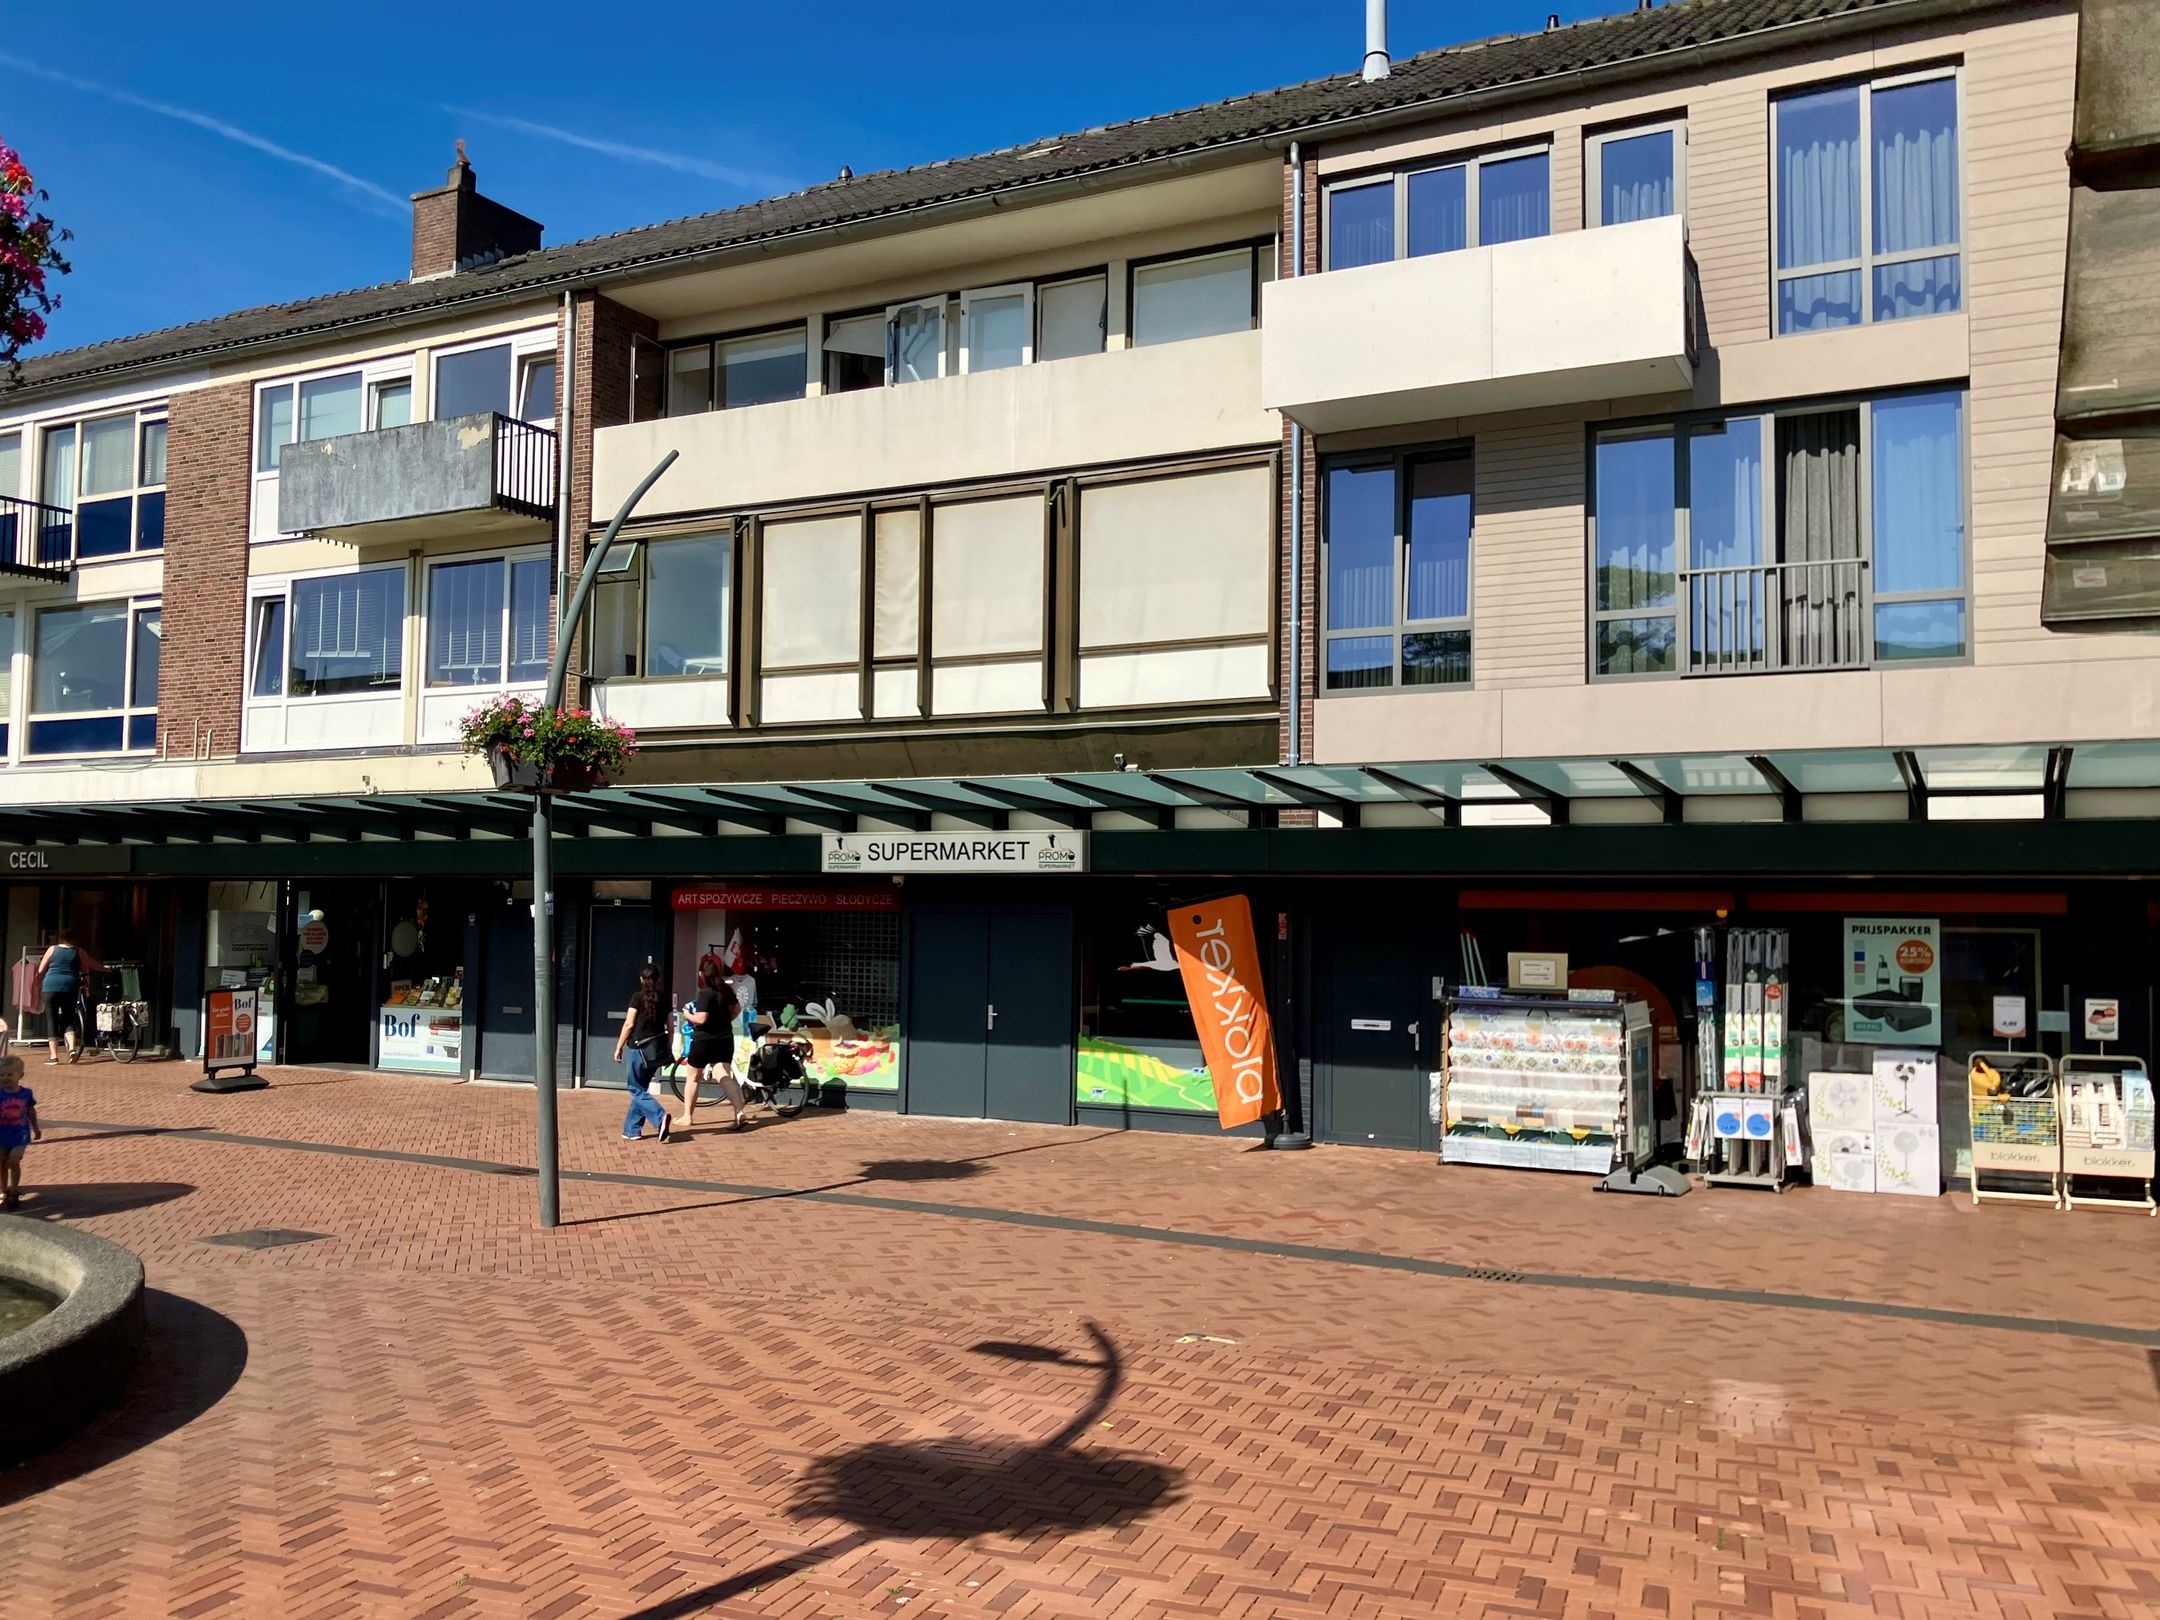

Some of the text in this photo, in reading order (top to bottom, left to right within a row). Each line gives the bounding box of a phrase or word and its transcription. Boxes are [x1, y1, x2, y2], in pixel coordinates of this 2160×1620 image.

[828, 851, 861, 862] PROMO
[868, 841, 1031, 862] SUPERMARKET
[1039, 850, 1076, 861] PROMO
[9, 851, 49, 869] CECIL
[771, 894, 828, 905] PIECZYWO
[1852, 925, 1932, 936] PRIJSPAKKER
[1900, 945, 1932, 958] 25%
[234, 997, 254, 1011] Bof
[384, 1013, 420, 1038] Bof
[1990, 1151, 2041, 1163] blokker.
[2083, 1156, 2136, 1168] blokker.
